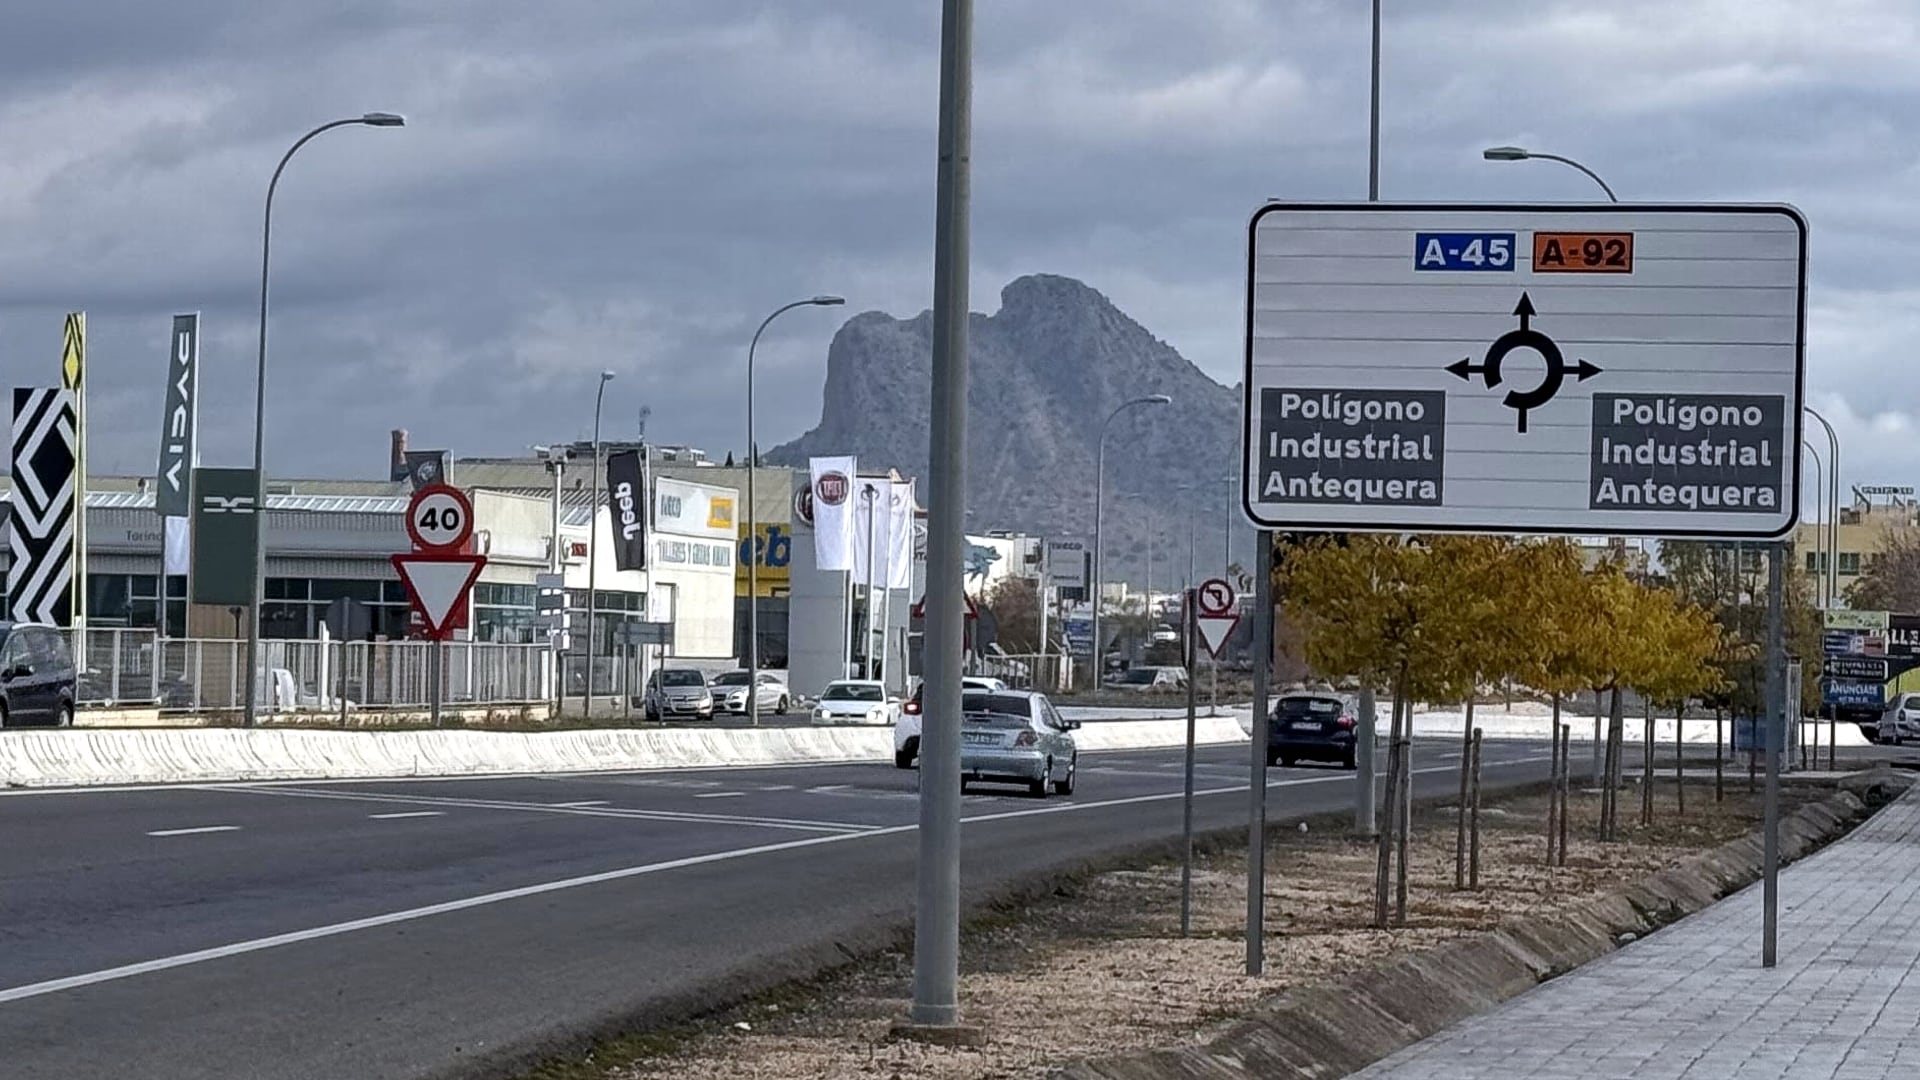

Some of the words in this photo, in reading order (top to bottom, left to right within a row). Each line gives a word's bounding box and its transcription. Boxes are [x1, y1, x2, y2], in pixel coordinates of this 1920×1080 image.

[1421, 239, 1511, 267] A-45
[1541, 239, 1627, 267] A-92
[1280, 393, 1425, 425] Polígono
[1613, 398, 1763, 430] Polígono
[1269, 431, 1433, 461] Industrial
[1601, 437, 1772, 467] Industrial
[1263, 470, 1437, 505] Antequera
[1595, 477, 1776, 510] Antequera
[419, 507, 460, 531] 40
